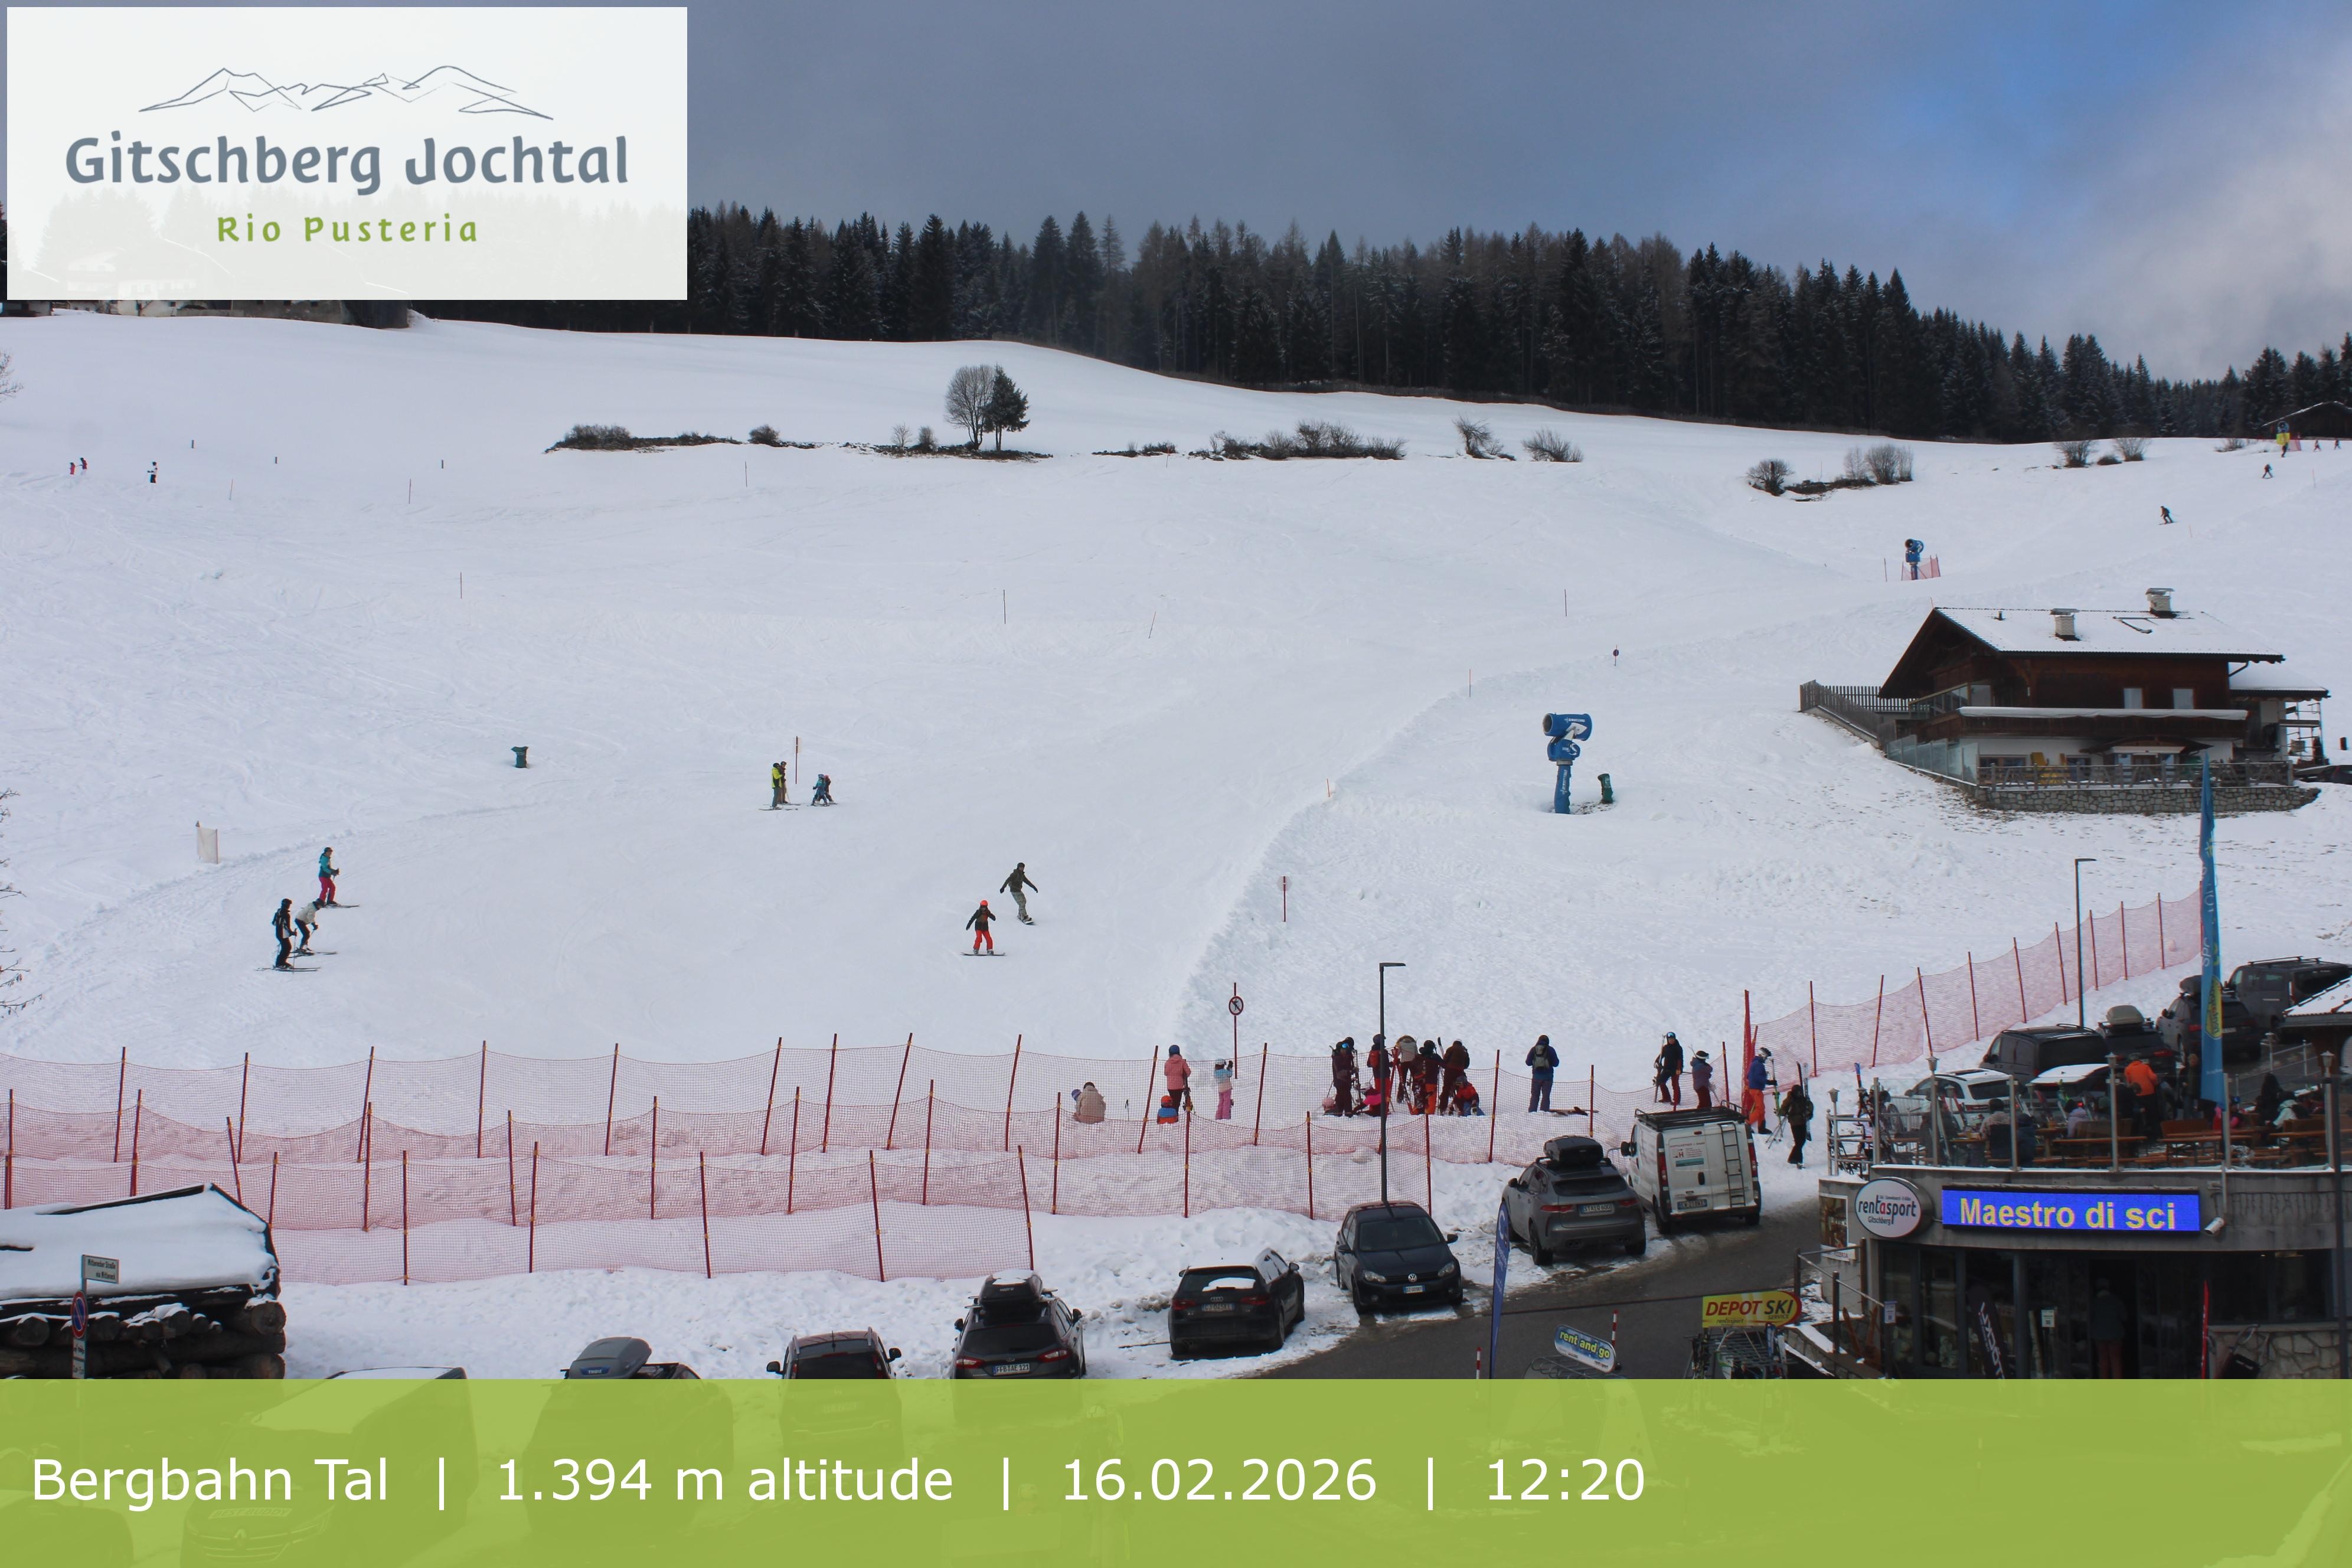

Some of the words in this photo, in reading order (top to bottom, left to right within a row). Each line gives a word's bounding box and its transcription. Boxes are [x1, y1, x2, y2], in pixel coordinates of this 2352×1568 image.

[1858, 1194, 1917, 1225] rentasport
[1868, 1216, 1891, 1226] Gitschberg
[1961, 1198, 2075, 1227] Maestro
[2085, 1202, 2115, 1229] di
[2125, 1203, 2176, 1229] sci
[1706, 1301, 1762, 1316] DEPOT
[1765, 1299, 1794, 1315] SKI
[1559, 1331, 1578, 1345] rent
[1579, 1340, 1598, 1353] and
[1599, 1347, 1611, 1358] go
